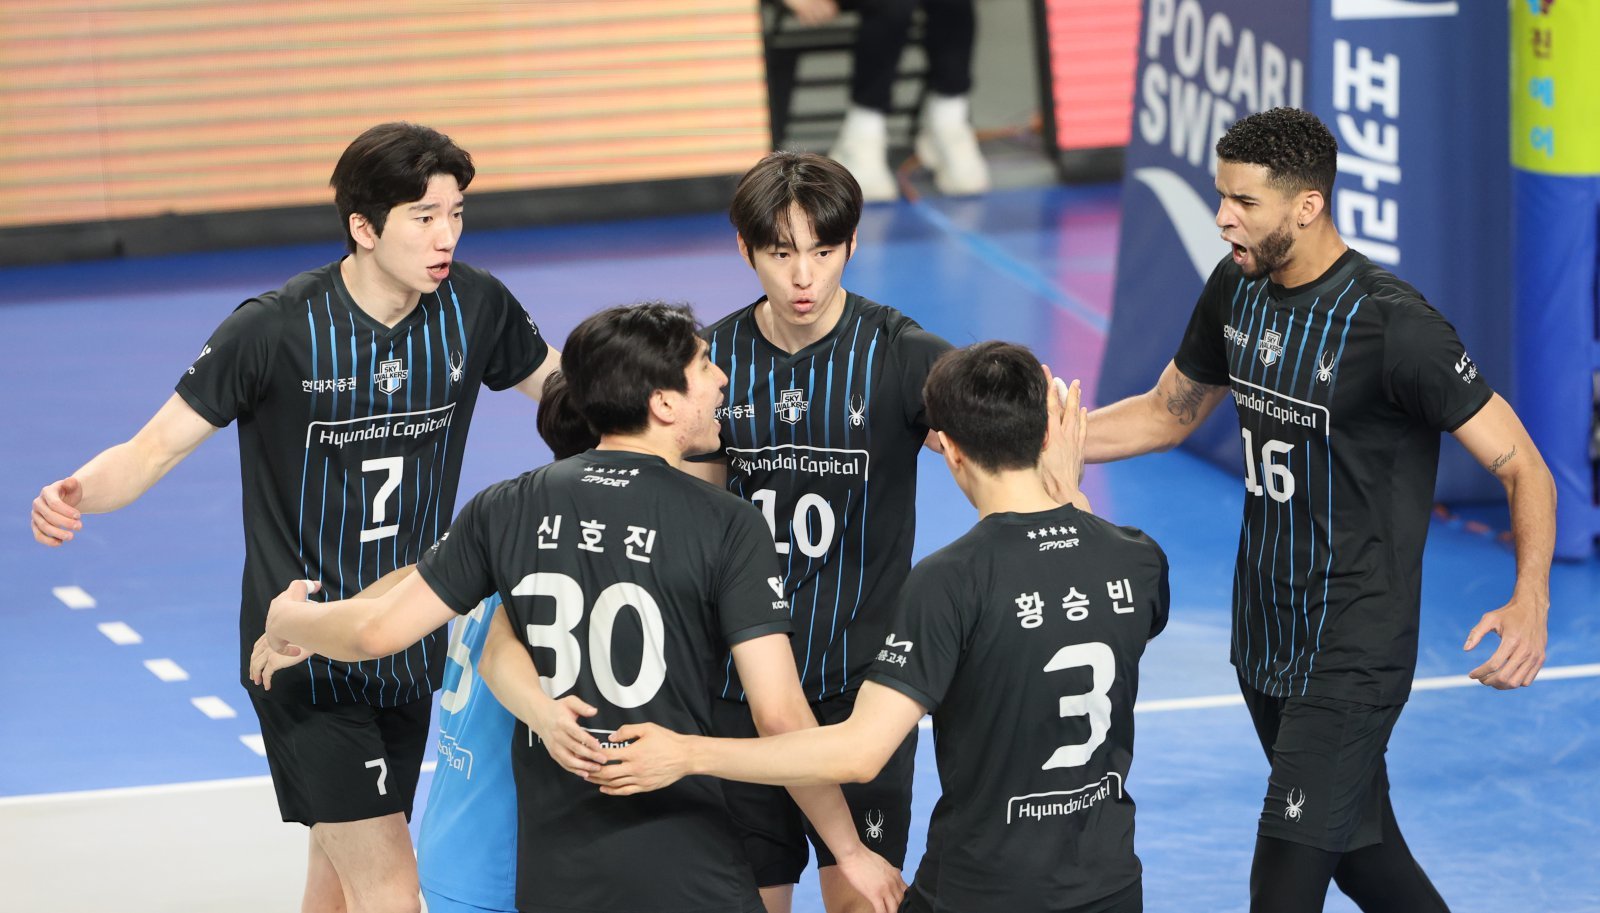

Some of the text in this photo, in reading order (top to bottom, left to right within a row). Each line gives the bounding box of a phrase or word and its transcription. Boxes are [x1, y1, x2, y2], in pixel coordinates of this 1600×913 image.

[1145, 0, 1304, 112] POCARI
[1139, 62, 1237, 177] SWE
[1333, 38, 1402, 266] 포카리
[374, 370, 408, 383] WALKERS
[384, 365, 398, 373] SKY
[301, 377, 357, 393] 현대차증권
[784, 394, 799, 403] SKY
[714, 404, 756, 420] 대차증권
[775, 401, 808, 413] WALKERS
[1266, 400, 1317, 429] Capital
[319, 412, 451, 450] Hyundai Capital
[800, 455, 859, 477] Capital
[1242, 427, 1295, 503] 16
[581, 474, 630, 488] SPYDER
[360, 456, 404, 542] 7
[751, 488, 835, 558] 10
[1039, 538, 1080, 552] SPYDER
[771, 600, 790, 610] KOV
[511, 572, 667, 709] 30
[1041, 641, 1116, 771] 3
[364, 757, 388, 796] 7
[1018, 796, 1082, 822] Hyundai
